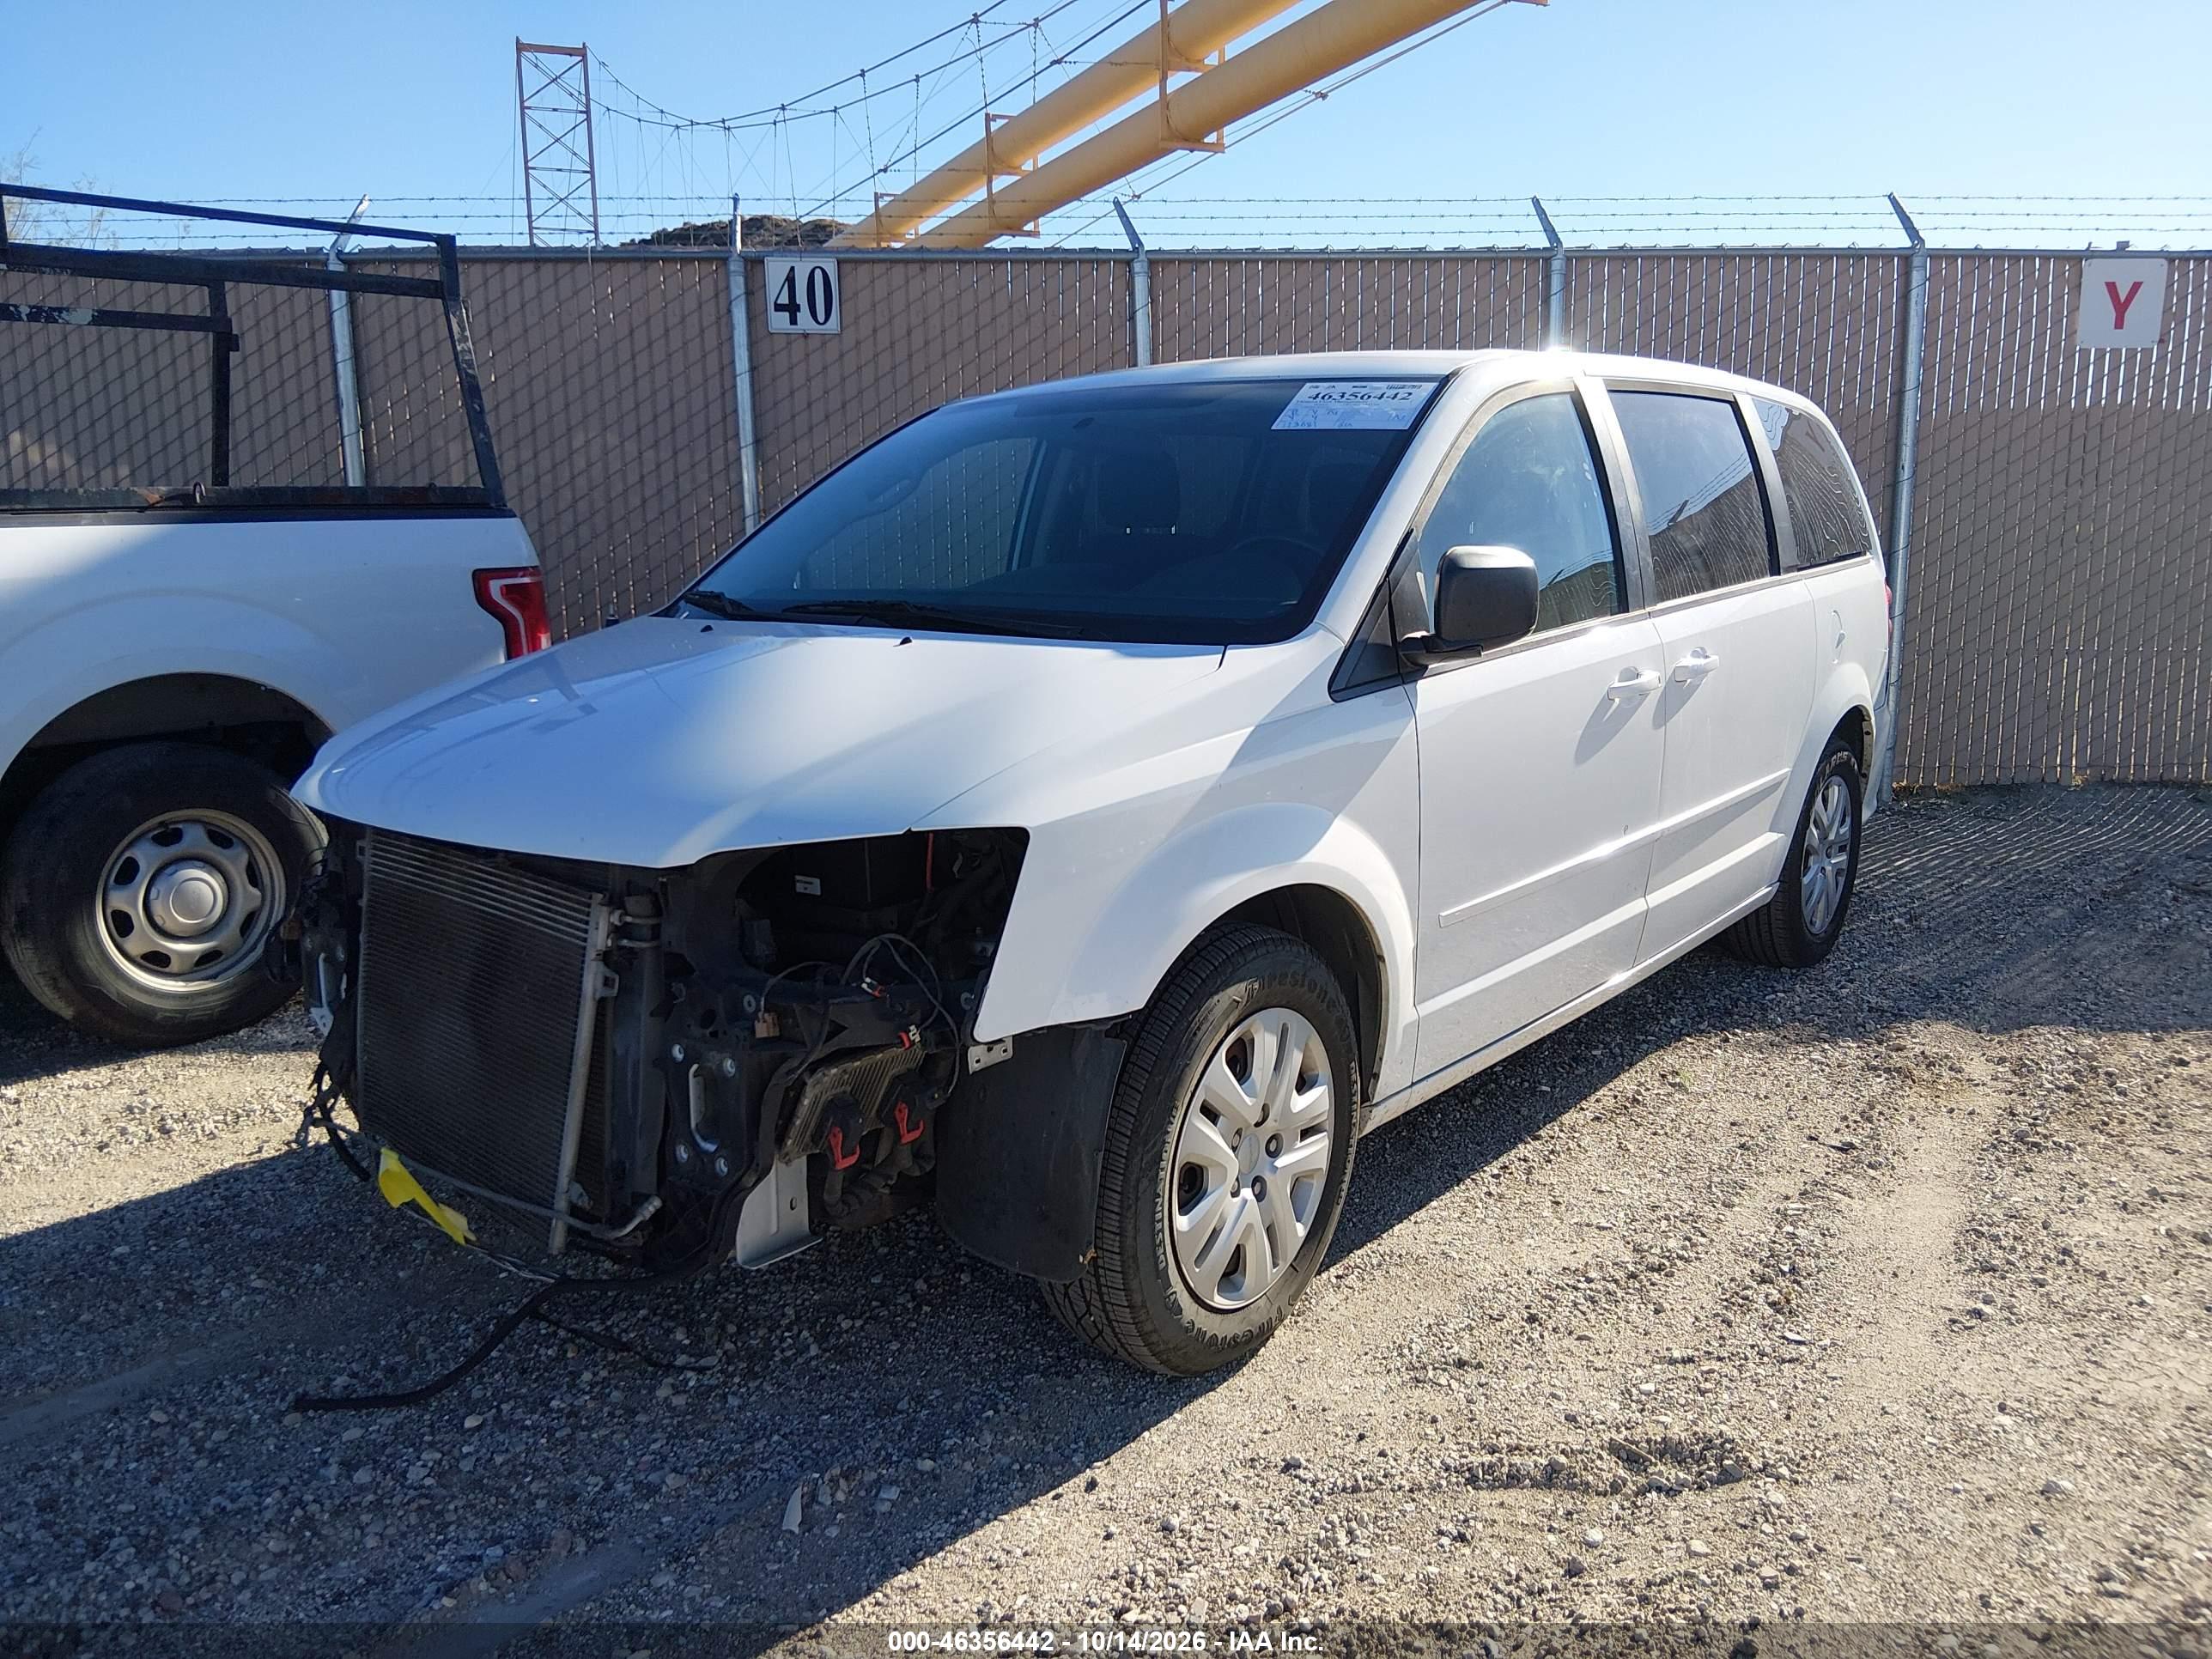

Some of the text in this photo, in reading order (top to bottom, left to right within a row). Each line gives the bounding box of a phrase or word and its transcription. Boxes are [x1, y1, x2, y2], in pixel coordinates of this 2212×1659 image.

[774, 265, 833, 325] 40
[2104, 282, 2144, 330] Y
[1308, 392, 1413, 400] 46356442
